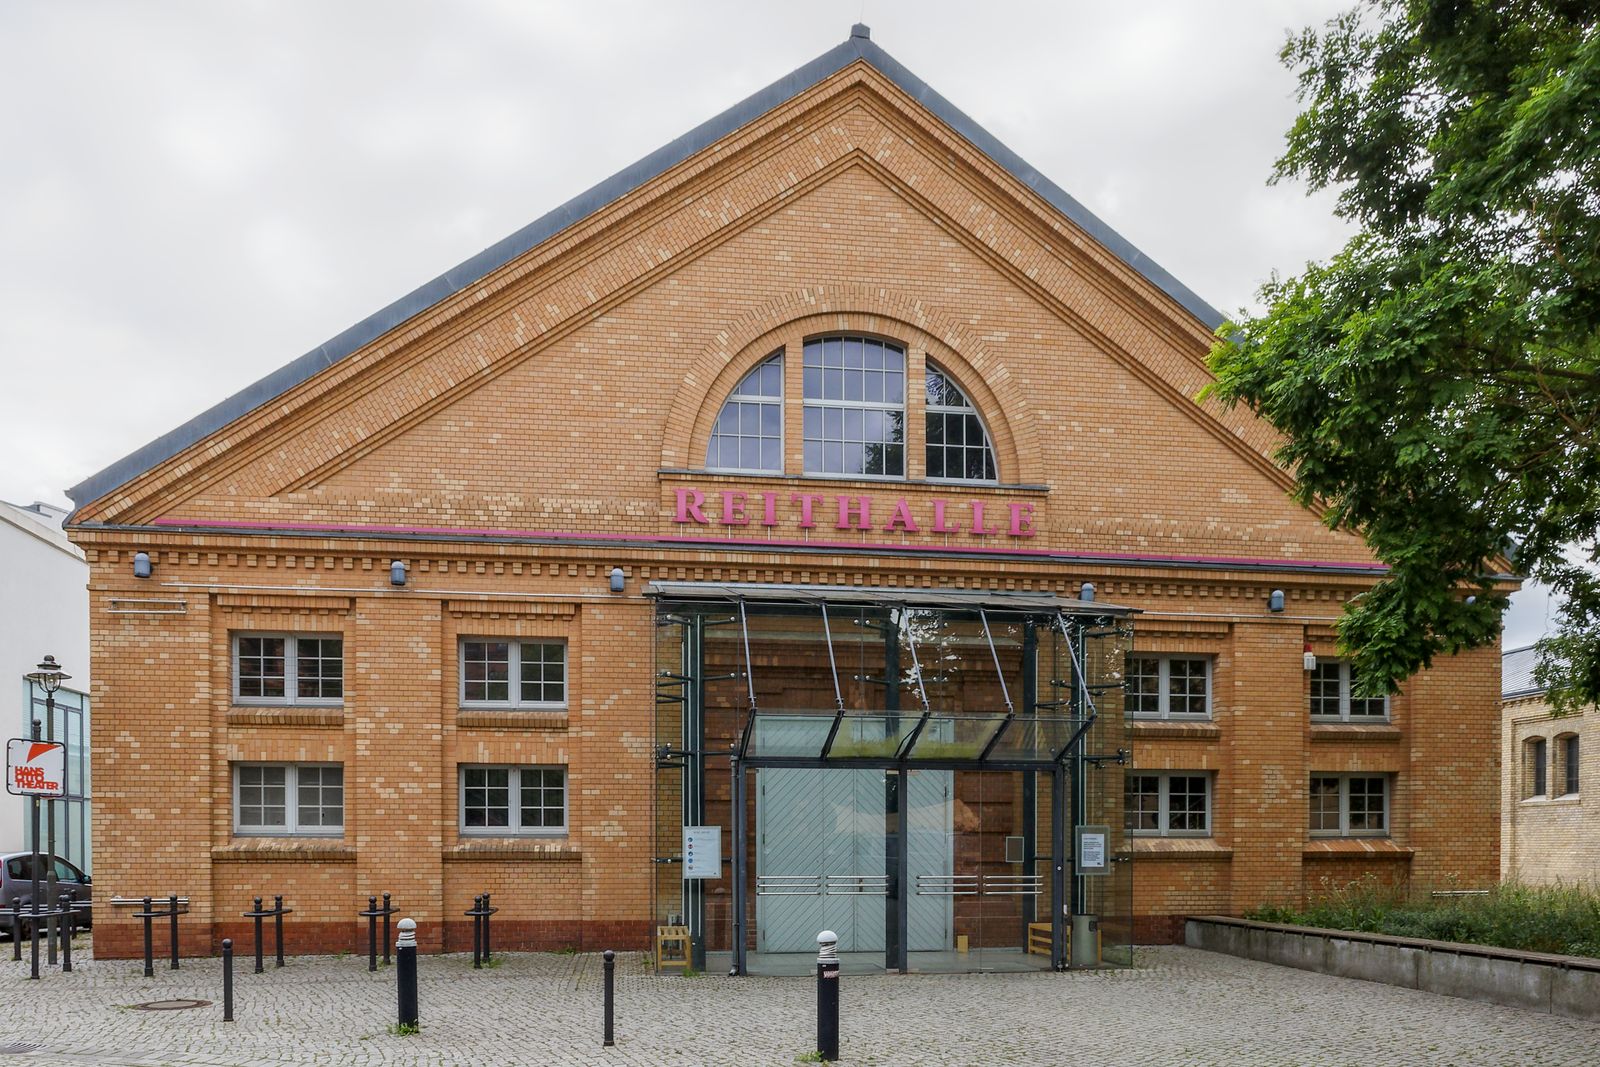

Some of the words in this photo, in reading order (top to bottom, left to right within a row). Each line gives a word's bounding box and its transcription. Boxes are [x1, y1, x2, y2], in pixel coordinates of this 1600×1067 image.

[672, 487, 1036, 537] REITHALLE
[15, 766, 44, 776] HANS
[15, 773, 44, 783] OTTO
[15, 780, 59, 790] THEATER
